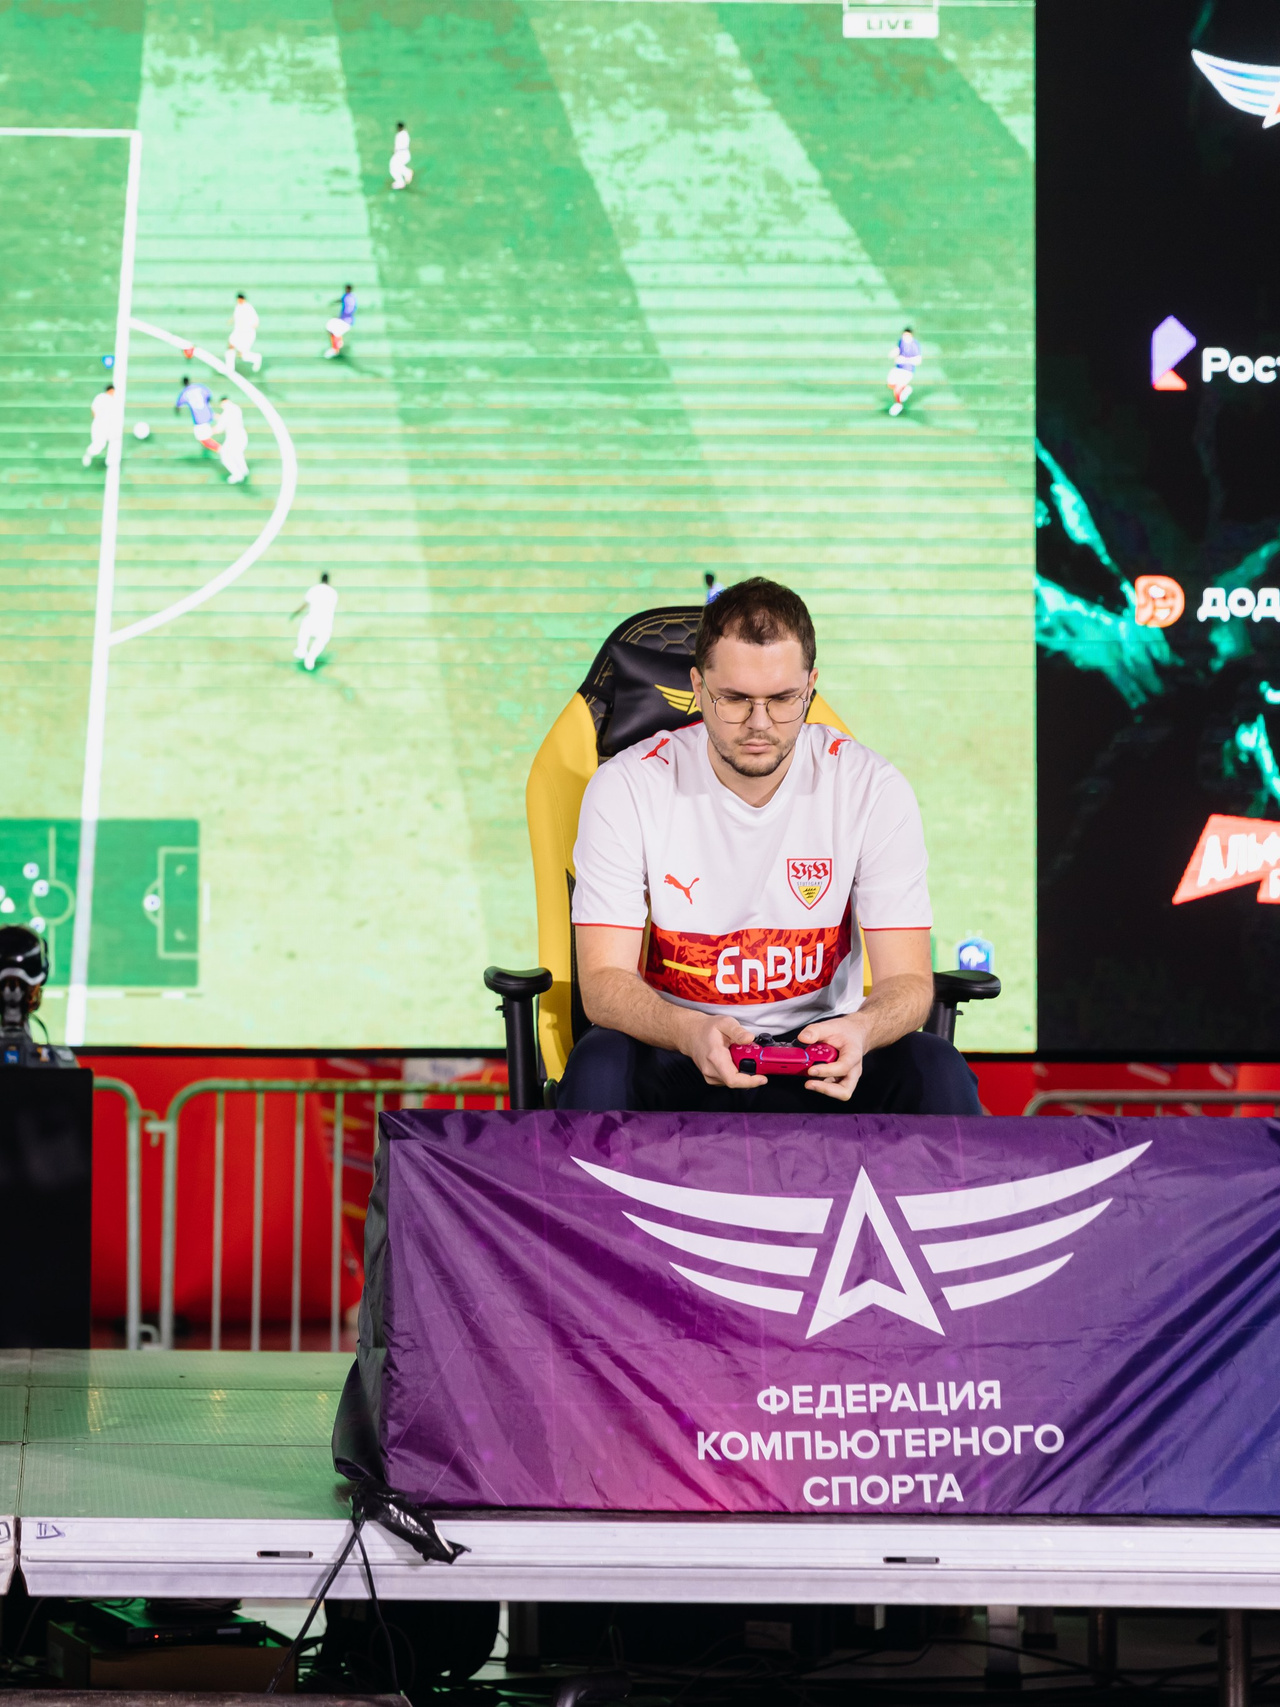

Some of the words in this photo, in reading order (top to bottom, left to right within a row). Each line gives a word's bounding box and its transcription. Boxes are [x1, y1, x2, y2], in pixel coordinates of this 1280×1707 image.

[867, 19, 913, 31] LIVE
[1201, 347, 1280, 383] Рос
[791, 861, 829, 881] VfB
[715, 943, 824, 995] EnBW
[756, 1379, 1002, 1419] ФЕДЕРАЦИЯ
[696, 1423, 1065, 1462] КОМПЬЮТЕРНОГО
[802, 1473, 964, 1506] СПОРТА
